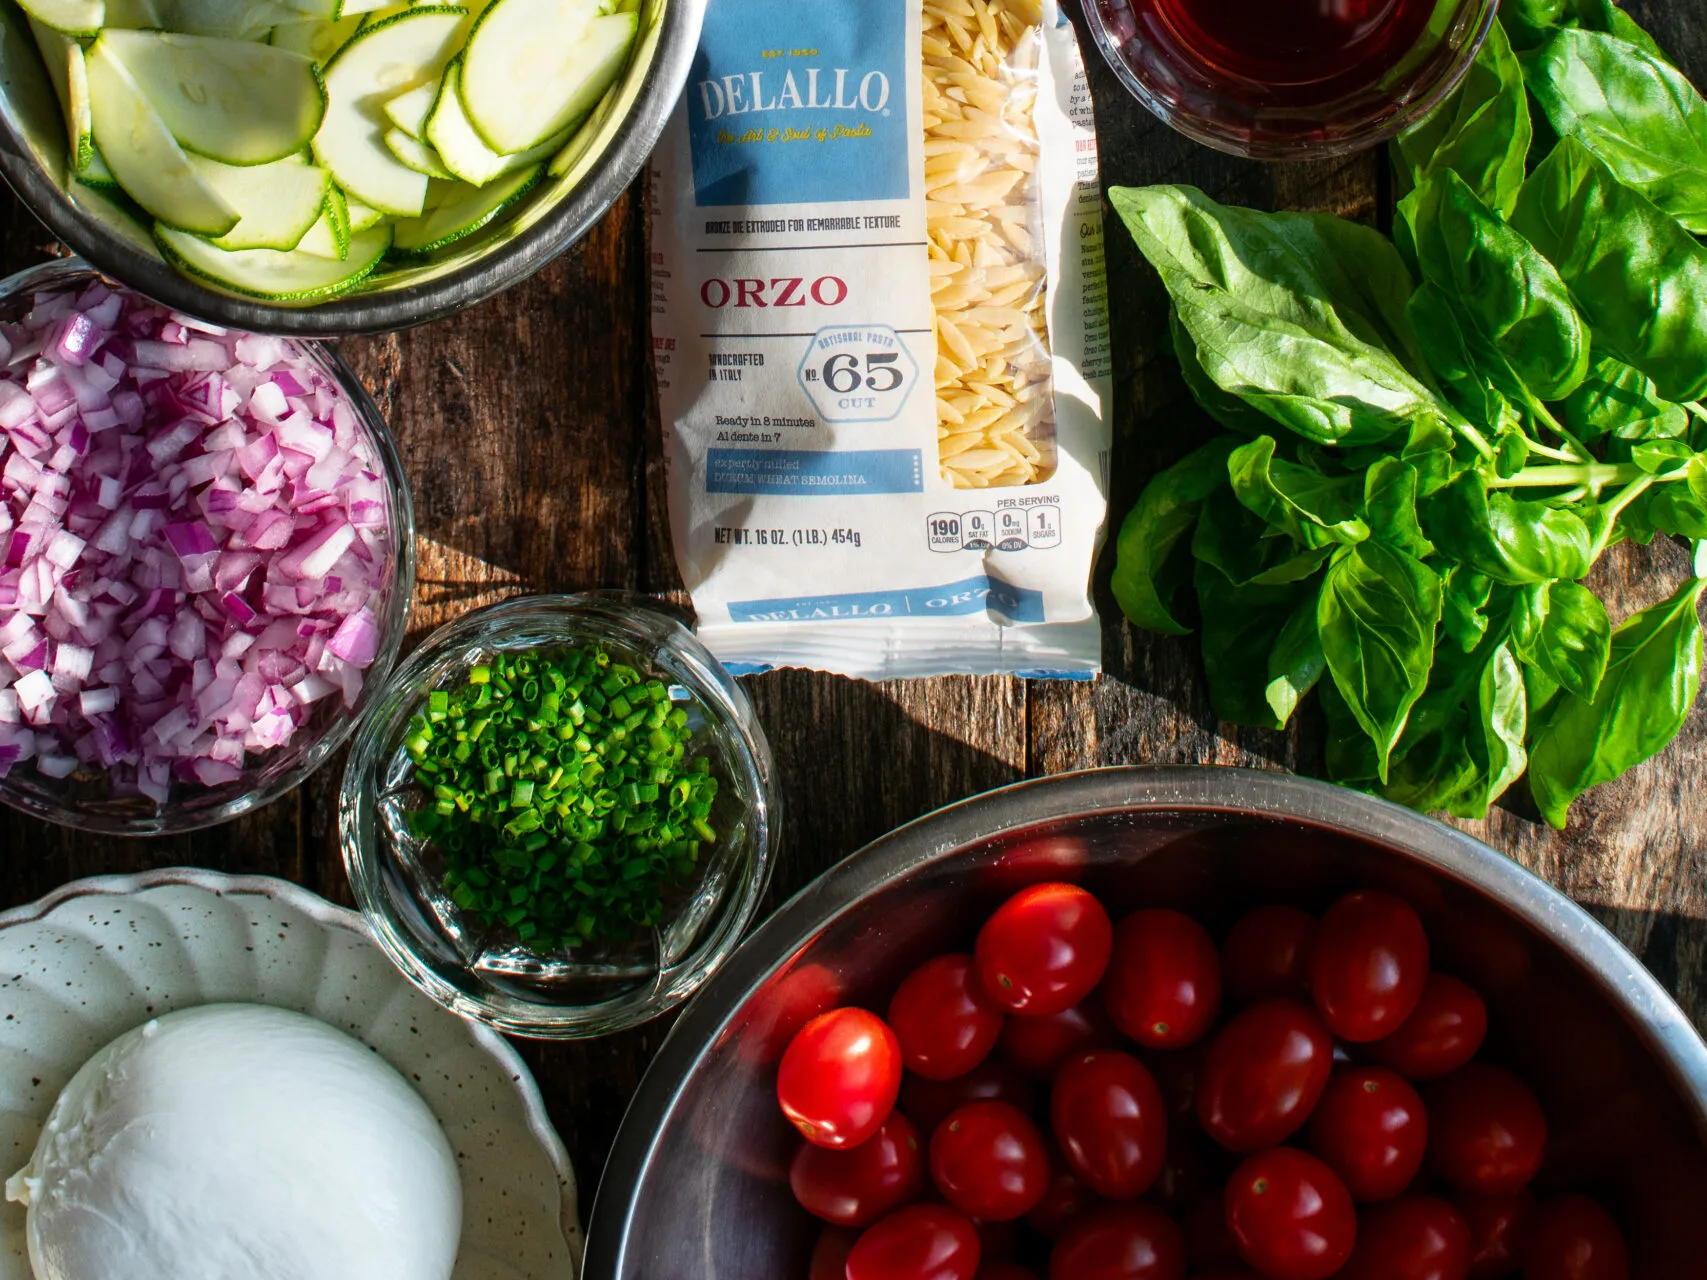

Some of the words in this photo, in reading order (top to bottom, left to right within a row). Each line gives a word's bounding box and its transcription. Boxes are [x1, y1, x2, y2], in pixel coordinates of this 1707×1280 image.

[697, 68, 890, 120] DELALLO
[781, 125, 811, 143] Soul
[814, 128, 827, 144] of
[829, 122, 873, 141] Pasta
[732, 220, 744, 234] DIE
[746, 219, 786, 234] EXTRUDED
[788, 218, 804, 232] FOR
[807, 216, 861, 232] REMARKABLE
[863, 215, 901, 230] TEXTURE
[700, 275, 848, 309] ORZO
[719, 368, 742, 381] ITALY
[822, 352, 904, 393] 65
[838, 396, 876, 409] CUT
[715, 415, 749, 429] Ready
[750, 416, 762, 426] in
[763, 416, 771, 426] 8
[772, 416, 815, 428] minutes
[716, 431, 729, 442] Al
[730, 431, 760, 442] dente
[761, 431, 773, 442] in
[774, 432, 782, 443] 7
[714, 457, 762, 471] expertly
[757, 472, 800, 485] WHEAT
[801, 473, 867, 486] SEMOLINA
[997, 499, 1017, 508] PER
[1018, 495, 1060, 507] SERVING
[930, 519, 959, 536] 190
[979, 530, 989, 538] FAT
[1001, 527, 1022, 536] SODIUM
[1032, 530, 1056, 539] SUGARS
[714, 527, 731, 544] NET
[734, 528, 753, 545] WT.
[755, 528, 768, 545] 16
[771, 529, 789, 545] OZ.
[792, 528, 803, 547] (1
[806, 528, 828, 547] LB.)
[831, 528, 861, 548] 454g
[931, 536, 960, 544] CALORIES
[749, 602, 892, 621] DELALLO
